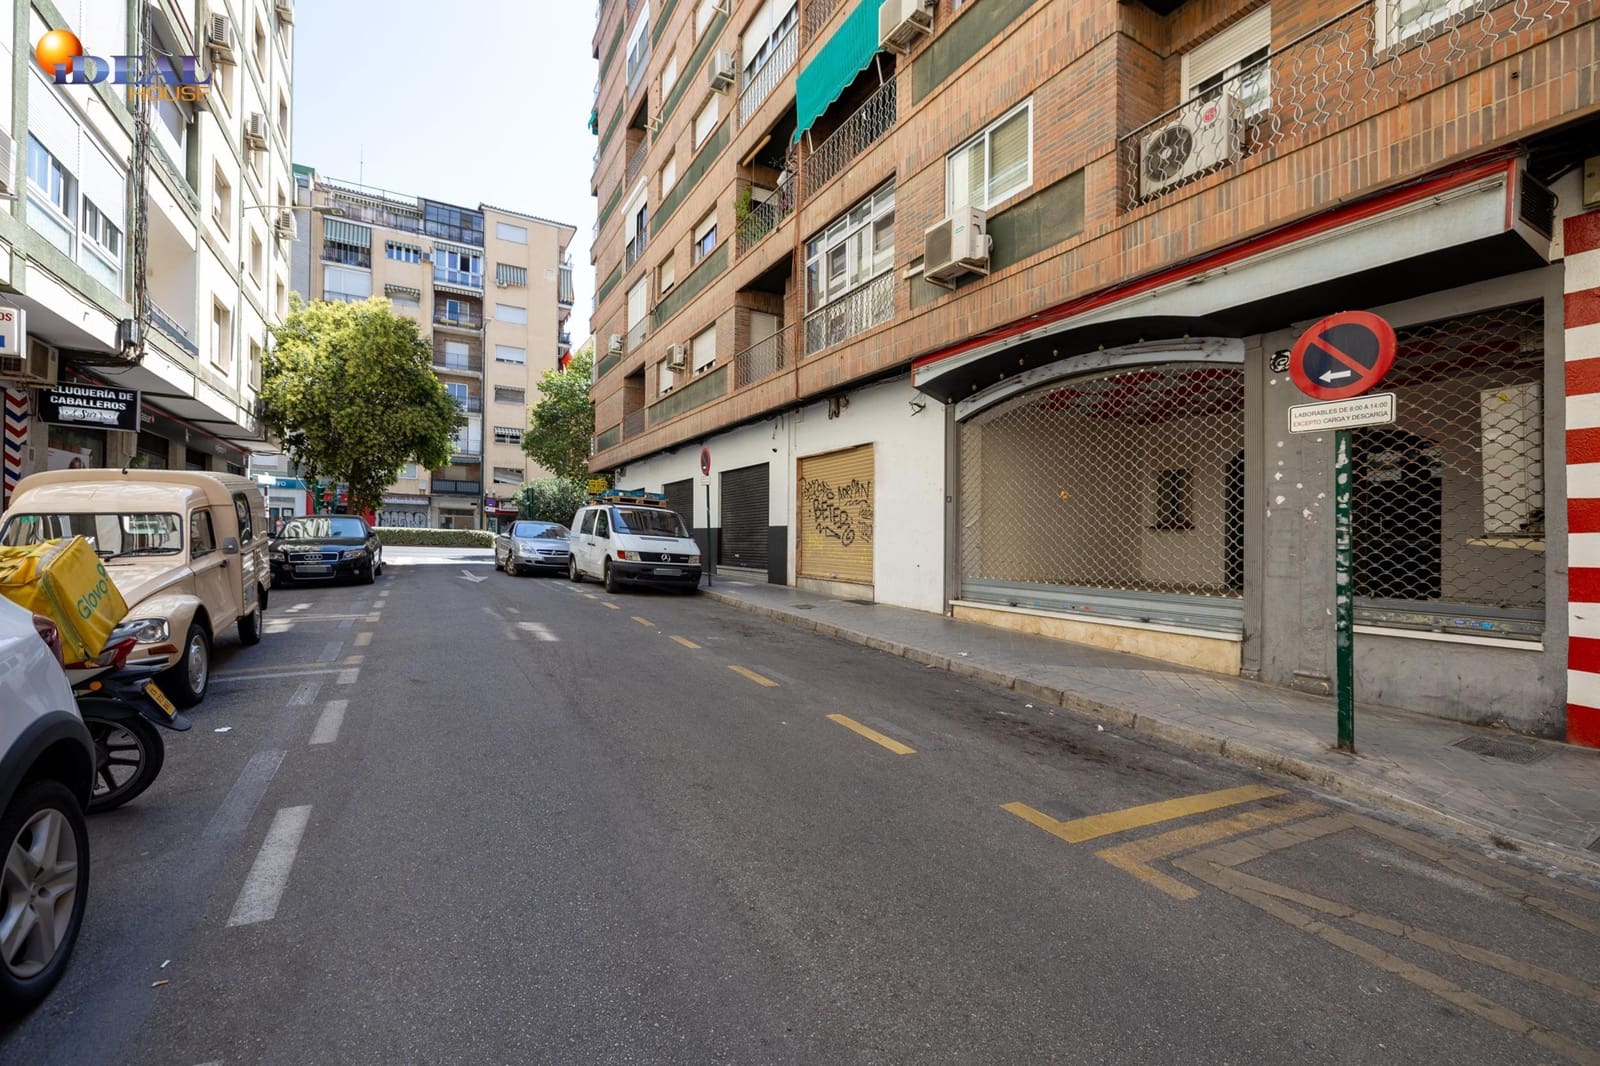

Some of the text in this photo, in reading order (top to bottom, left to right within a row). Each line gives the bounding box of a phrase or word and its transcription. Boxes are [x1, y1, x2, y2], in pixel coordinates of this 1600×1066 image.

[49, 395, 127, 410] CABALLEROS
[118, 391, 134, 401] DE
[1292, 419, 1322, 428] EXCEPTO
[1322, 416, 1346, 424] CARGA
[1351, 410, 1389, 421] DESCARGA
[1294, 408, 1338, 419] LABORABLES
[77, 580, 109, 620] Glovo
